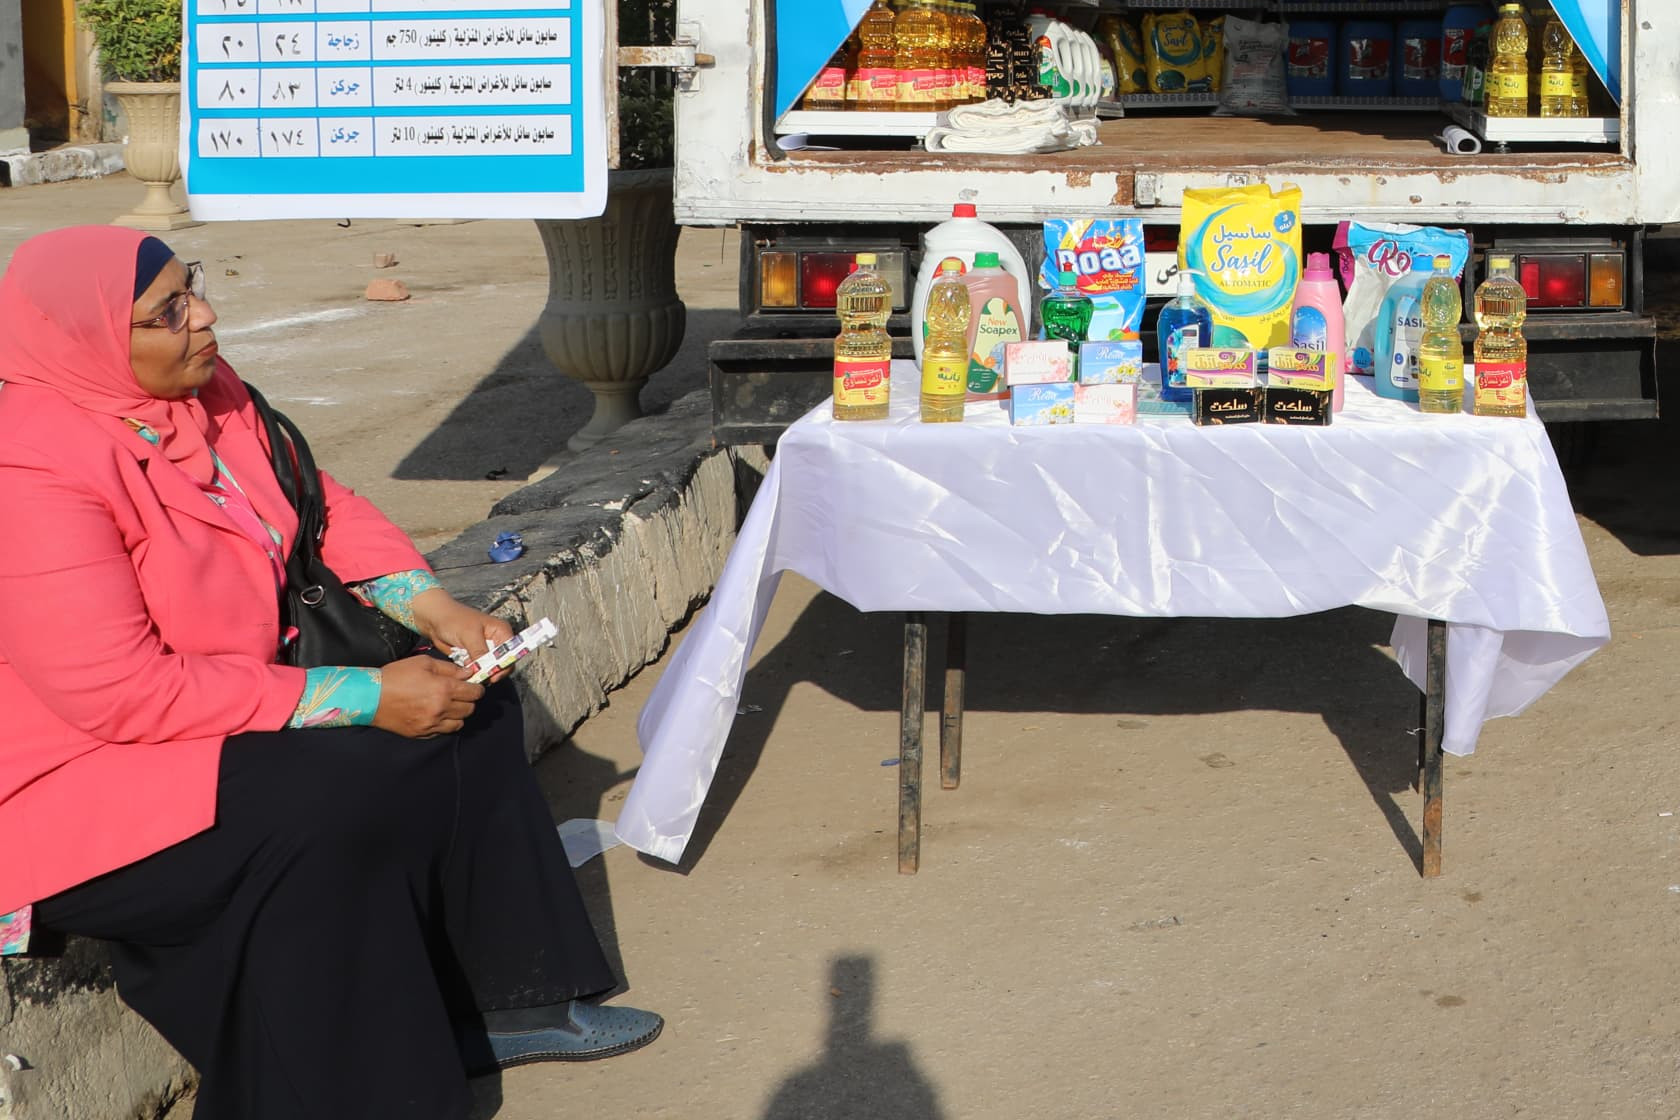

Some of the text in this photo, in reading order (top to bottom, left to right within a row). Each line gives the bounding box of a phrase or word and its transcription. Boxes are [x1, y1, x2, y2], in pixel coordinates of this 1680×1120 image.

[328, 34, 359, 50] زجاجة
[400, 29, 417, 43] 750
[535, 30, 557, 45] صابون
[222, 36, 243, 58] ٢٠
[219, 80, 245, 100] ٨٠
[331, 80, 360, 95] جركن
[331, 128, 359, 143] جركن
[1213, 224, 1271, 243] ساسيل
[1212, 244, 1272, 273] Sasil
[987, 318, 1007, 326] New
[1398, 317, 1425, 328] SASI
[979, 324, 1018, 336] Soapex
[1210, 399, 1248, 412] سلكت
[1274, 400, 1312, 412] سلكت
